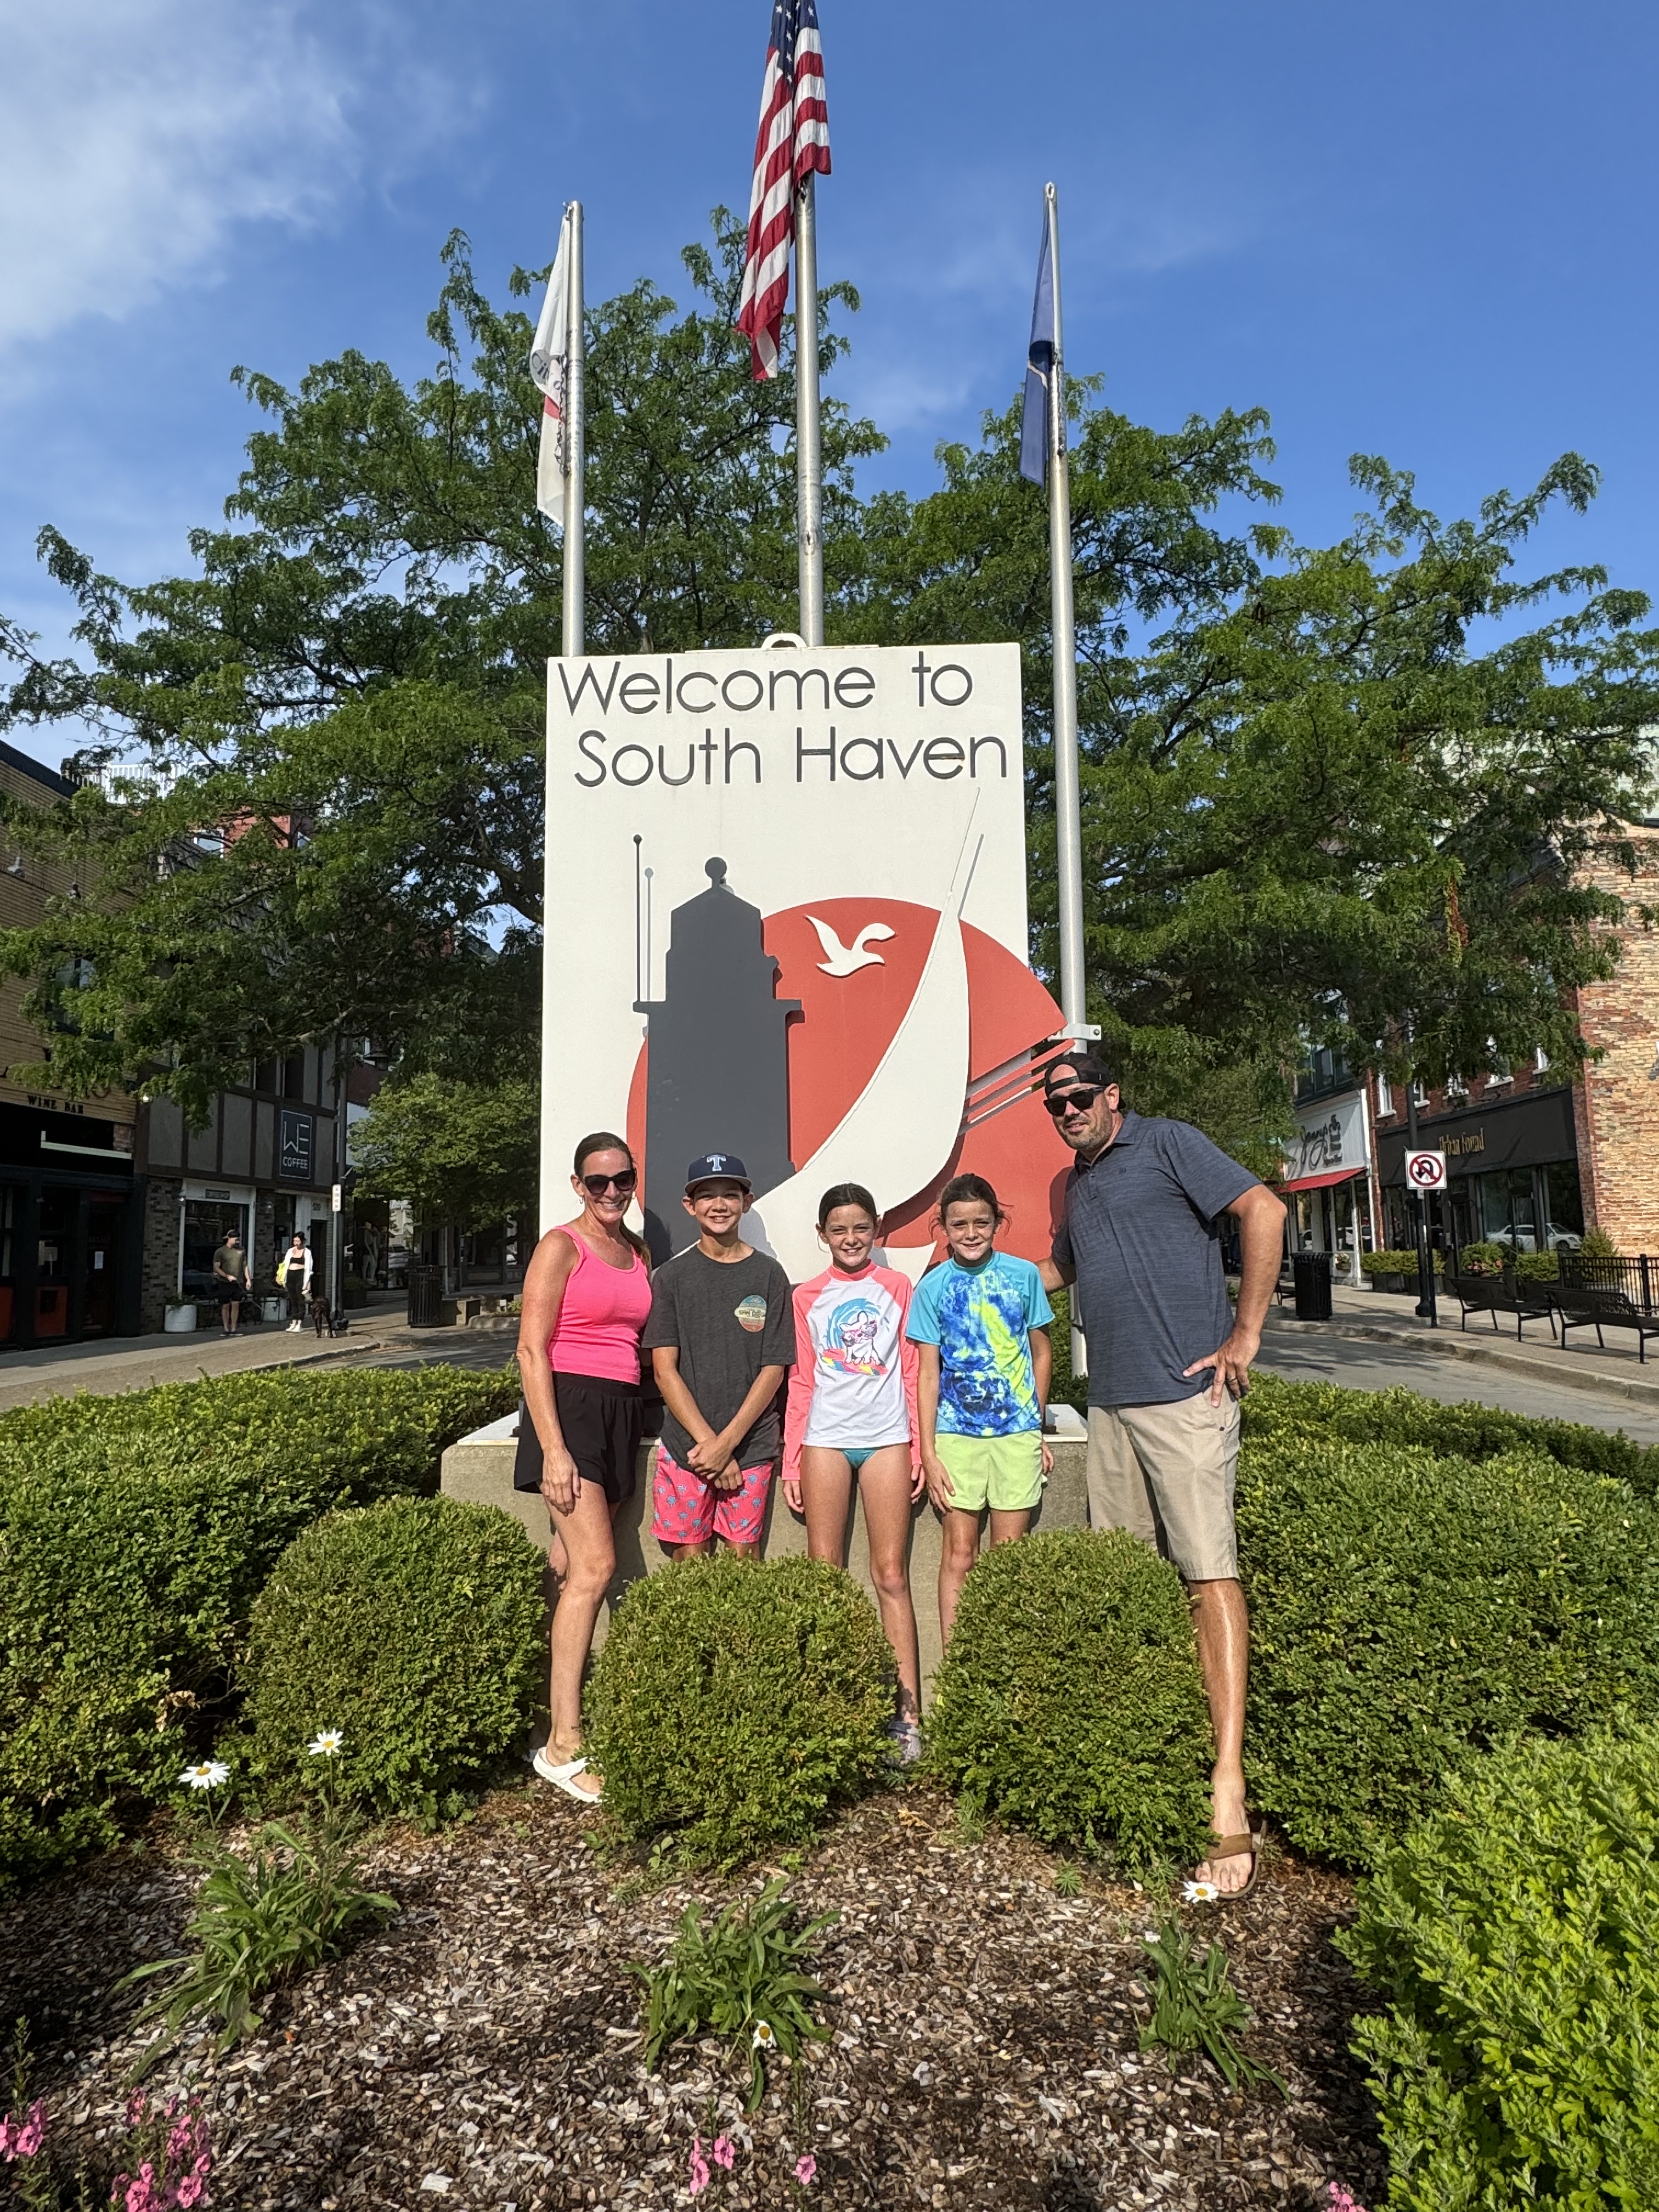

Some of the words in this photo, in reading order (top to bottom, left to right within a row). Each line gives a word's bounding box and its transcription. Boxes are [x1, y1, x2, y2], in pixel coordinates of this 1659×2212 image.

[557, 658, 876, 716] Welcome
[911, 650, 973, 708] to
[574, 726, 762, 787] South
[796, 725, 1007, 783] Haven
[27, 1094, 57, 1109] WINE
[65, 1101, 83, 1114] BAR
[283, 1120, 309, 1155] WE
[283, 1156, 308, 1170] COFFEE
[707, 1154, 726, 1172] T
